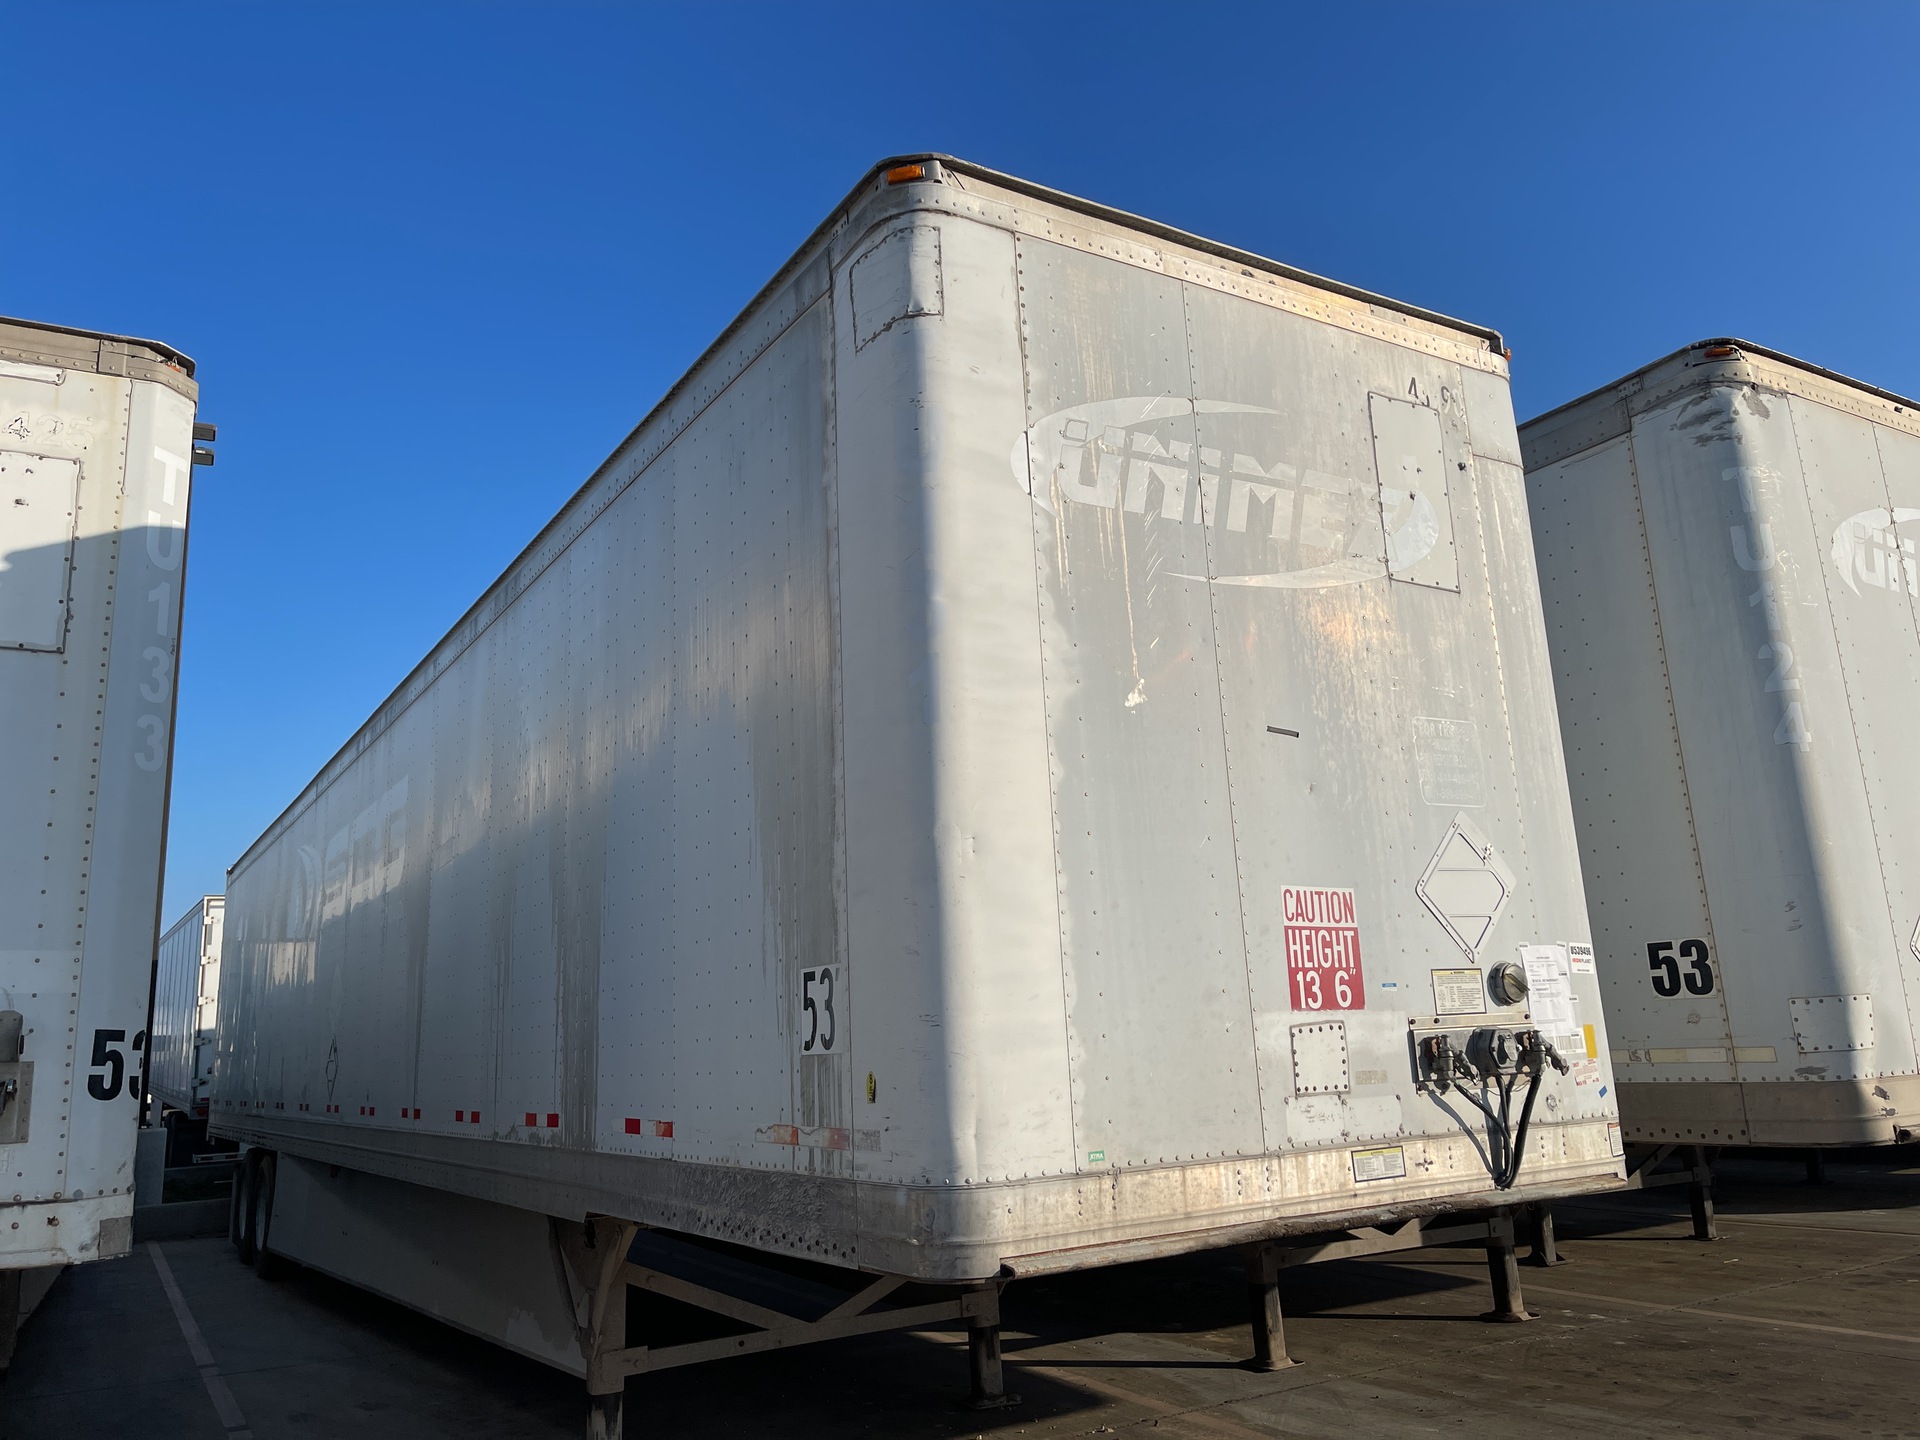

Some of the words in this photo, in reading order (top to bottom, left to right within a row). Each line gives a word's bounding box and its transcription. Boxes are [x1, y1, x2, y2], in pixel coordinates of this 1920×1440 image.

[1283, 888, 1355, 923] CAUTION
[1288, 929, 1355, 968] HEIGHT
[1647, 939, 1714, 997] 53
